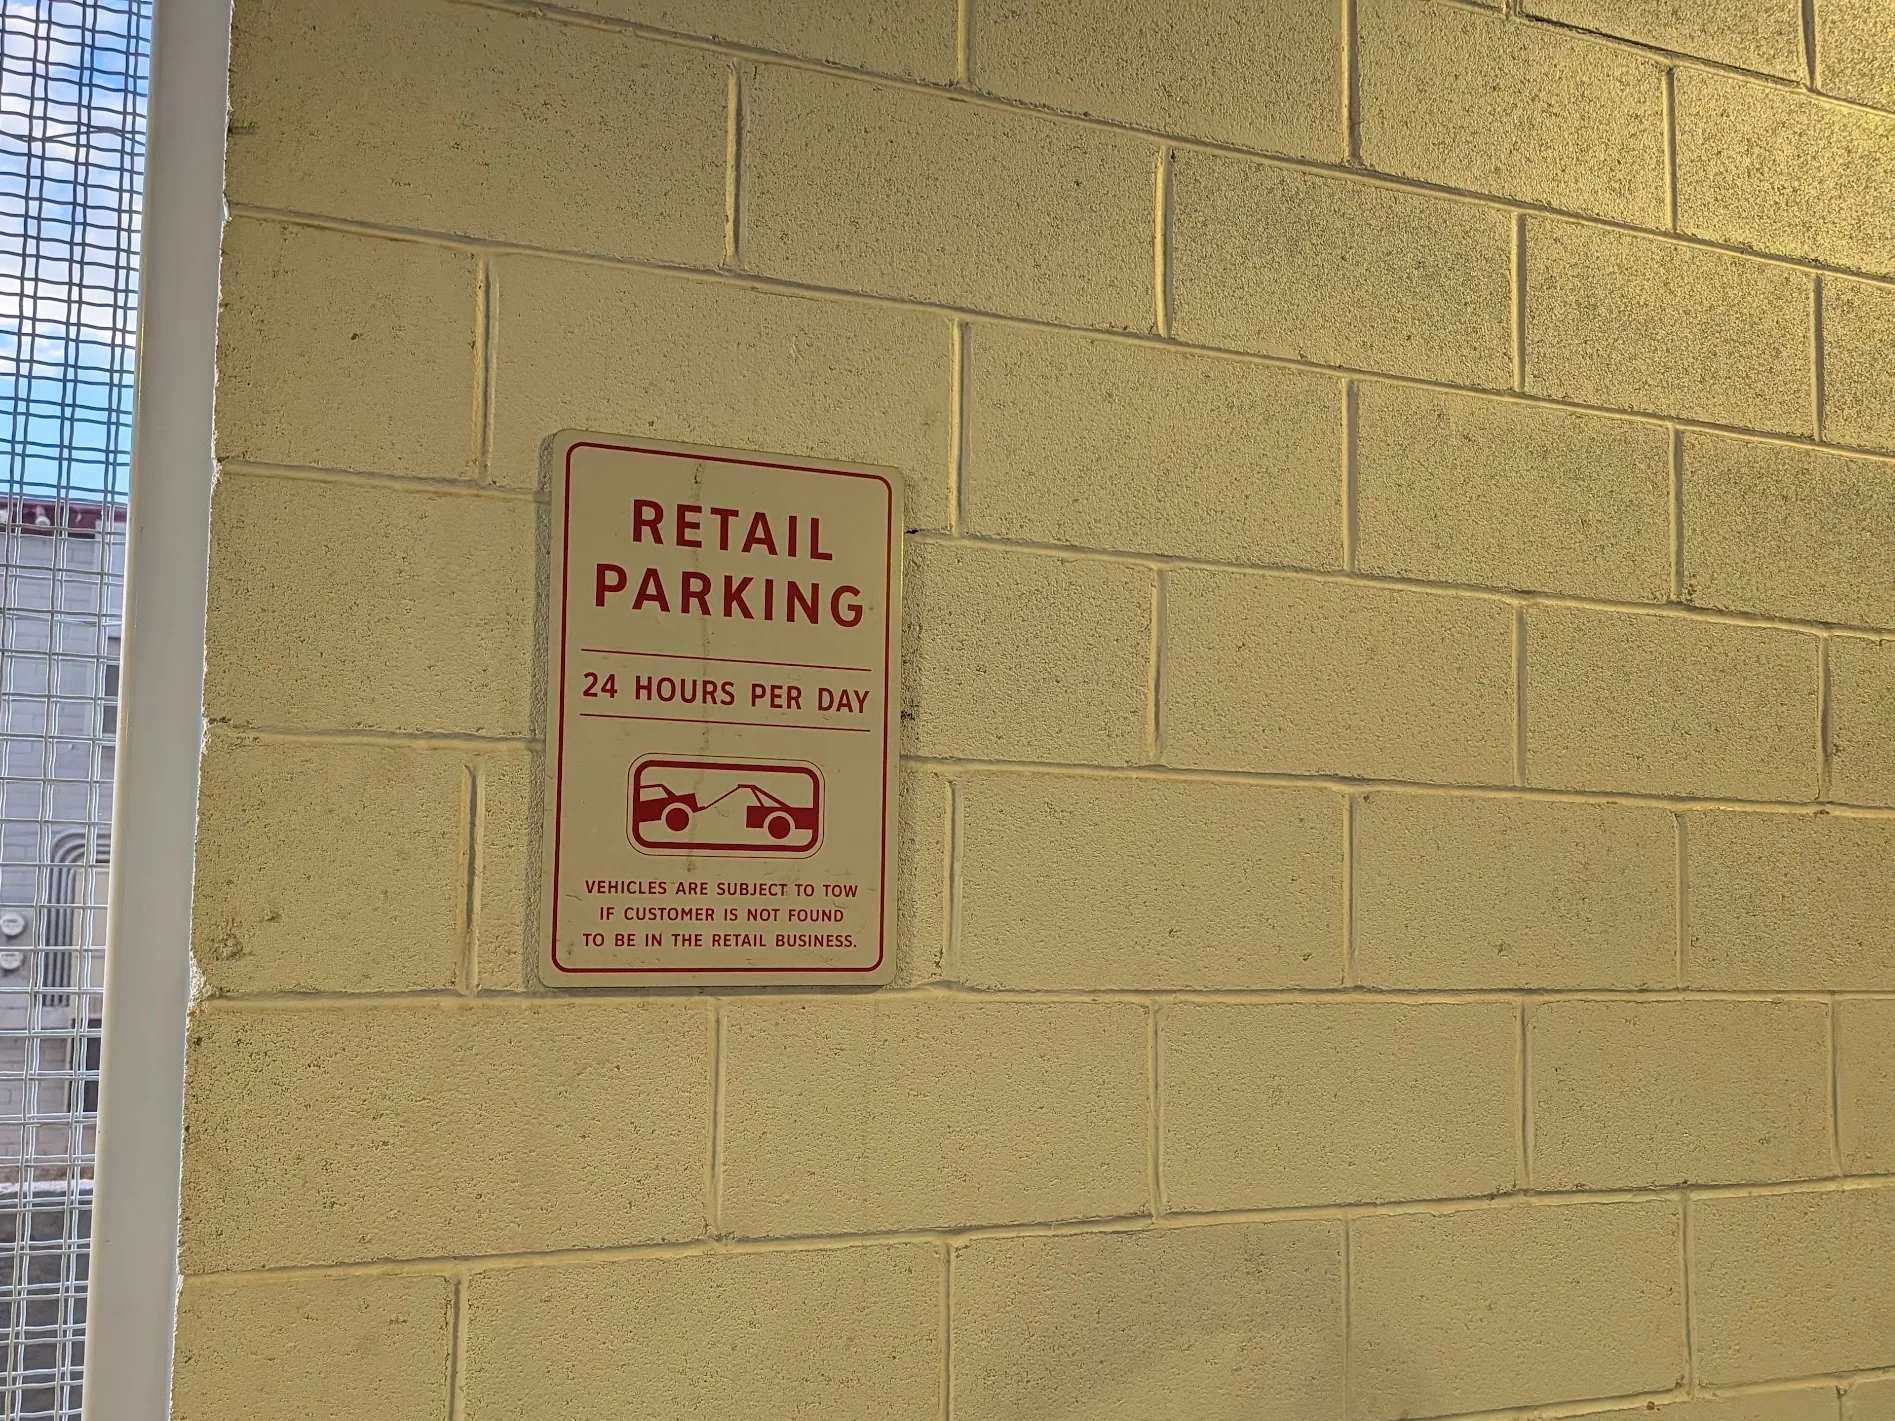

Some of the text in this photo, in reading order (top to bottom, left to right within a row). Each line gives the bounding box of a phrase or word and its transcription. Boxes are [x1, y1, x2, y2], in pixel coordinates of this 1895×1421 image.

[632, 498, 833, 560] RETAIL
[594, 562, 864, 628] PARKING
[582, 671, 869, 713] 24 HOURS PER DAY
[586, 880, 859, 898] VEHICLES ARE SUBJECT TO TOW
[599, 907, 845, 922] IF CUSTOMER IS NOT FOUND
[583, 933, 857, 948] TO BE IN THE RETAIL BUSINESS.
